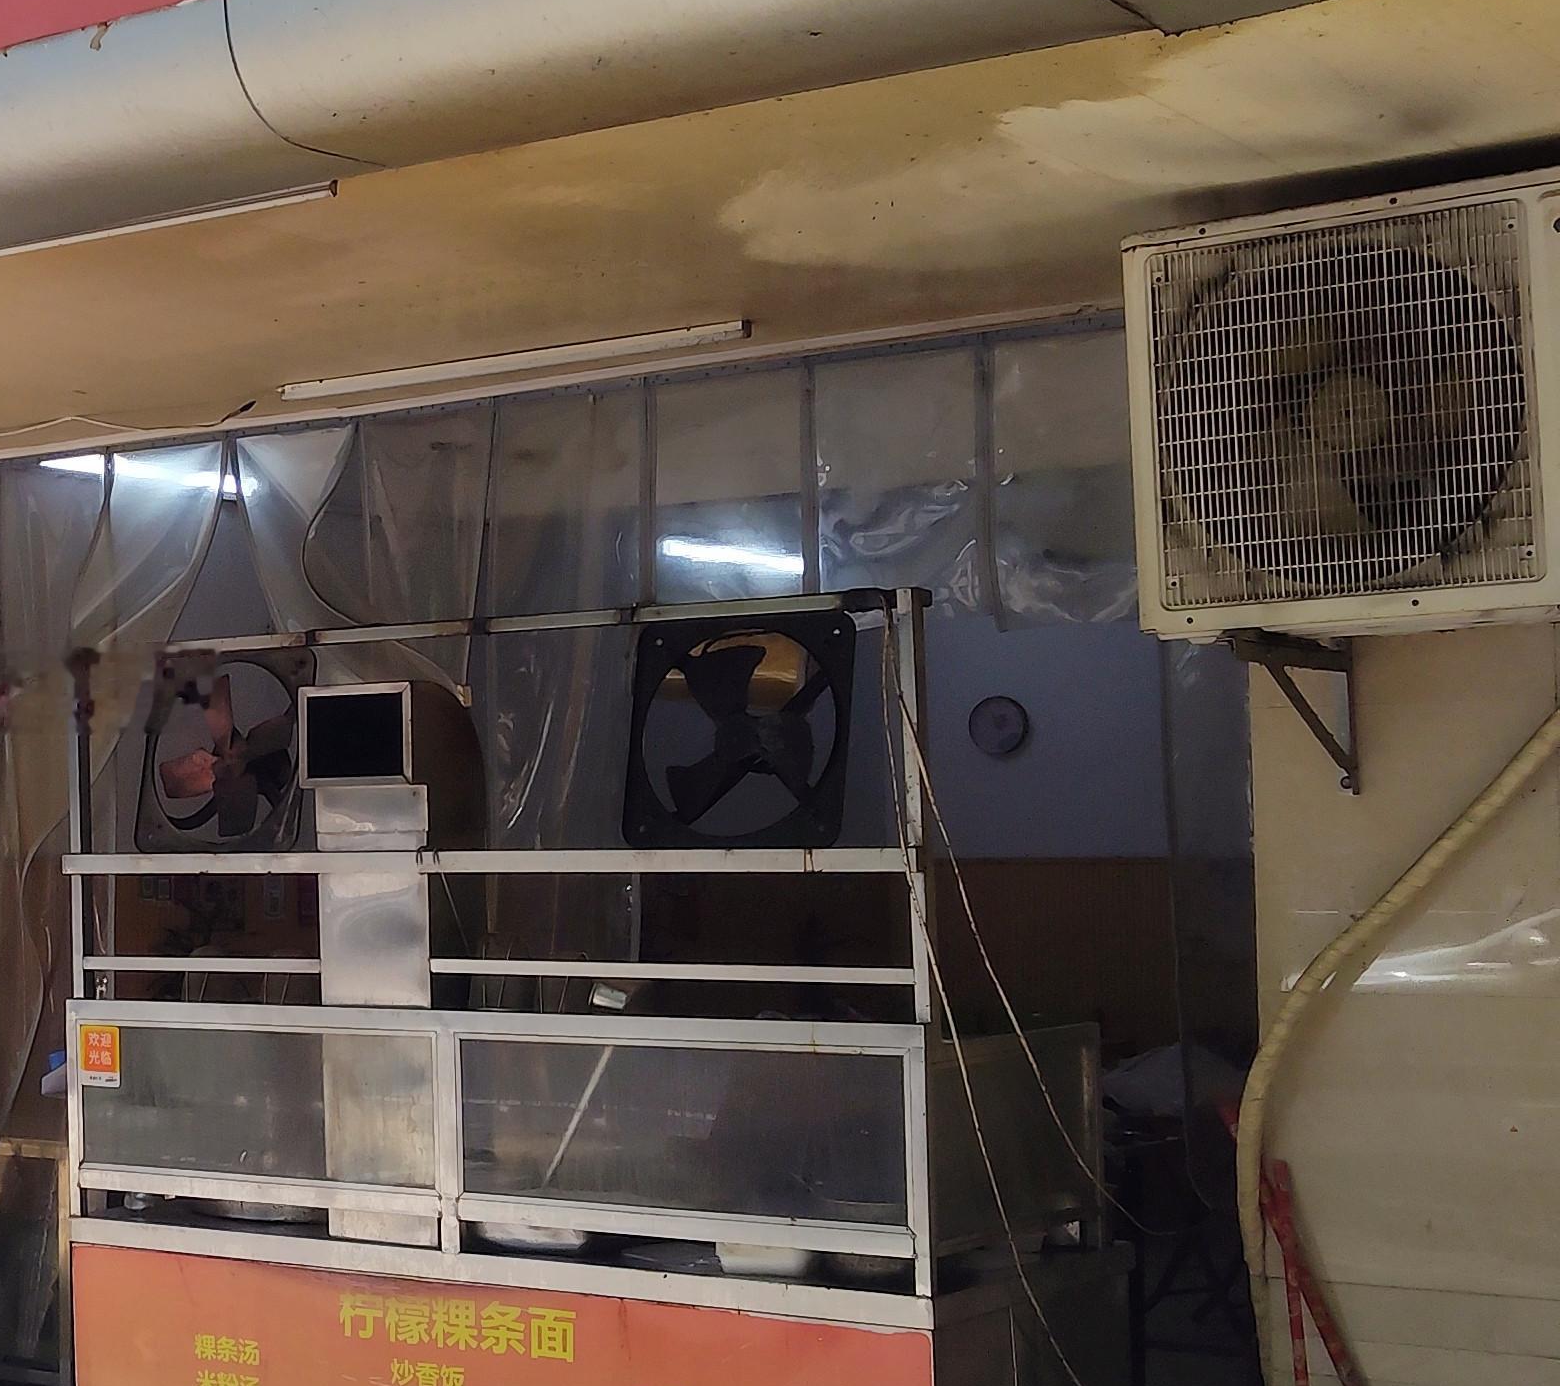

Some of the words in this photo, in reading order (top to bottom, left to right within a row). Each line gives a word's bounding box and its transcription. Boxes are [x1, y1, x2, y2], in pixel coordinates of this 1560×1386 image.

[88, 1031, 112, 1047] 欢迎
[88, 1050, 112, 1065] 光临
[340, 1293, 576, 1363] 柠檬粿条面
[194, 1333, 260, 1365] 粿条汤
